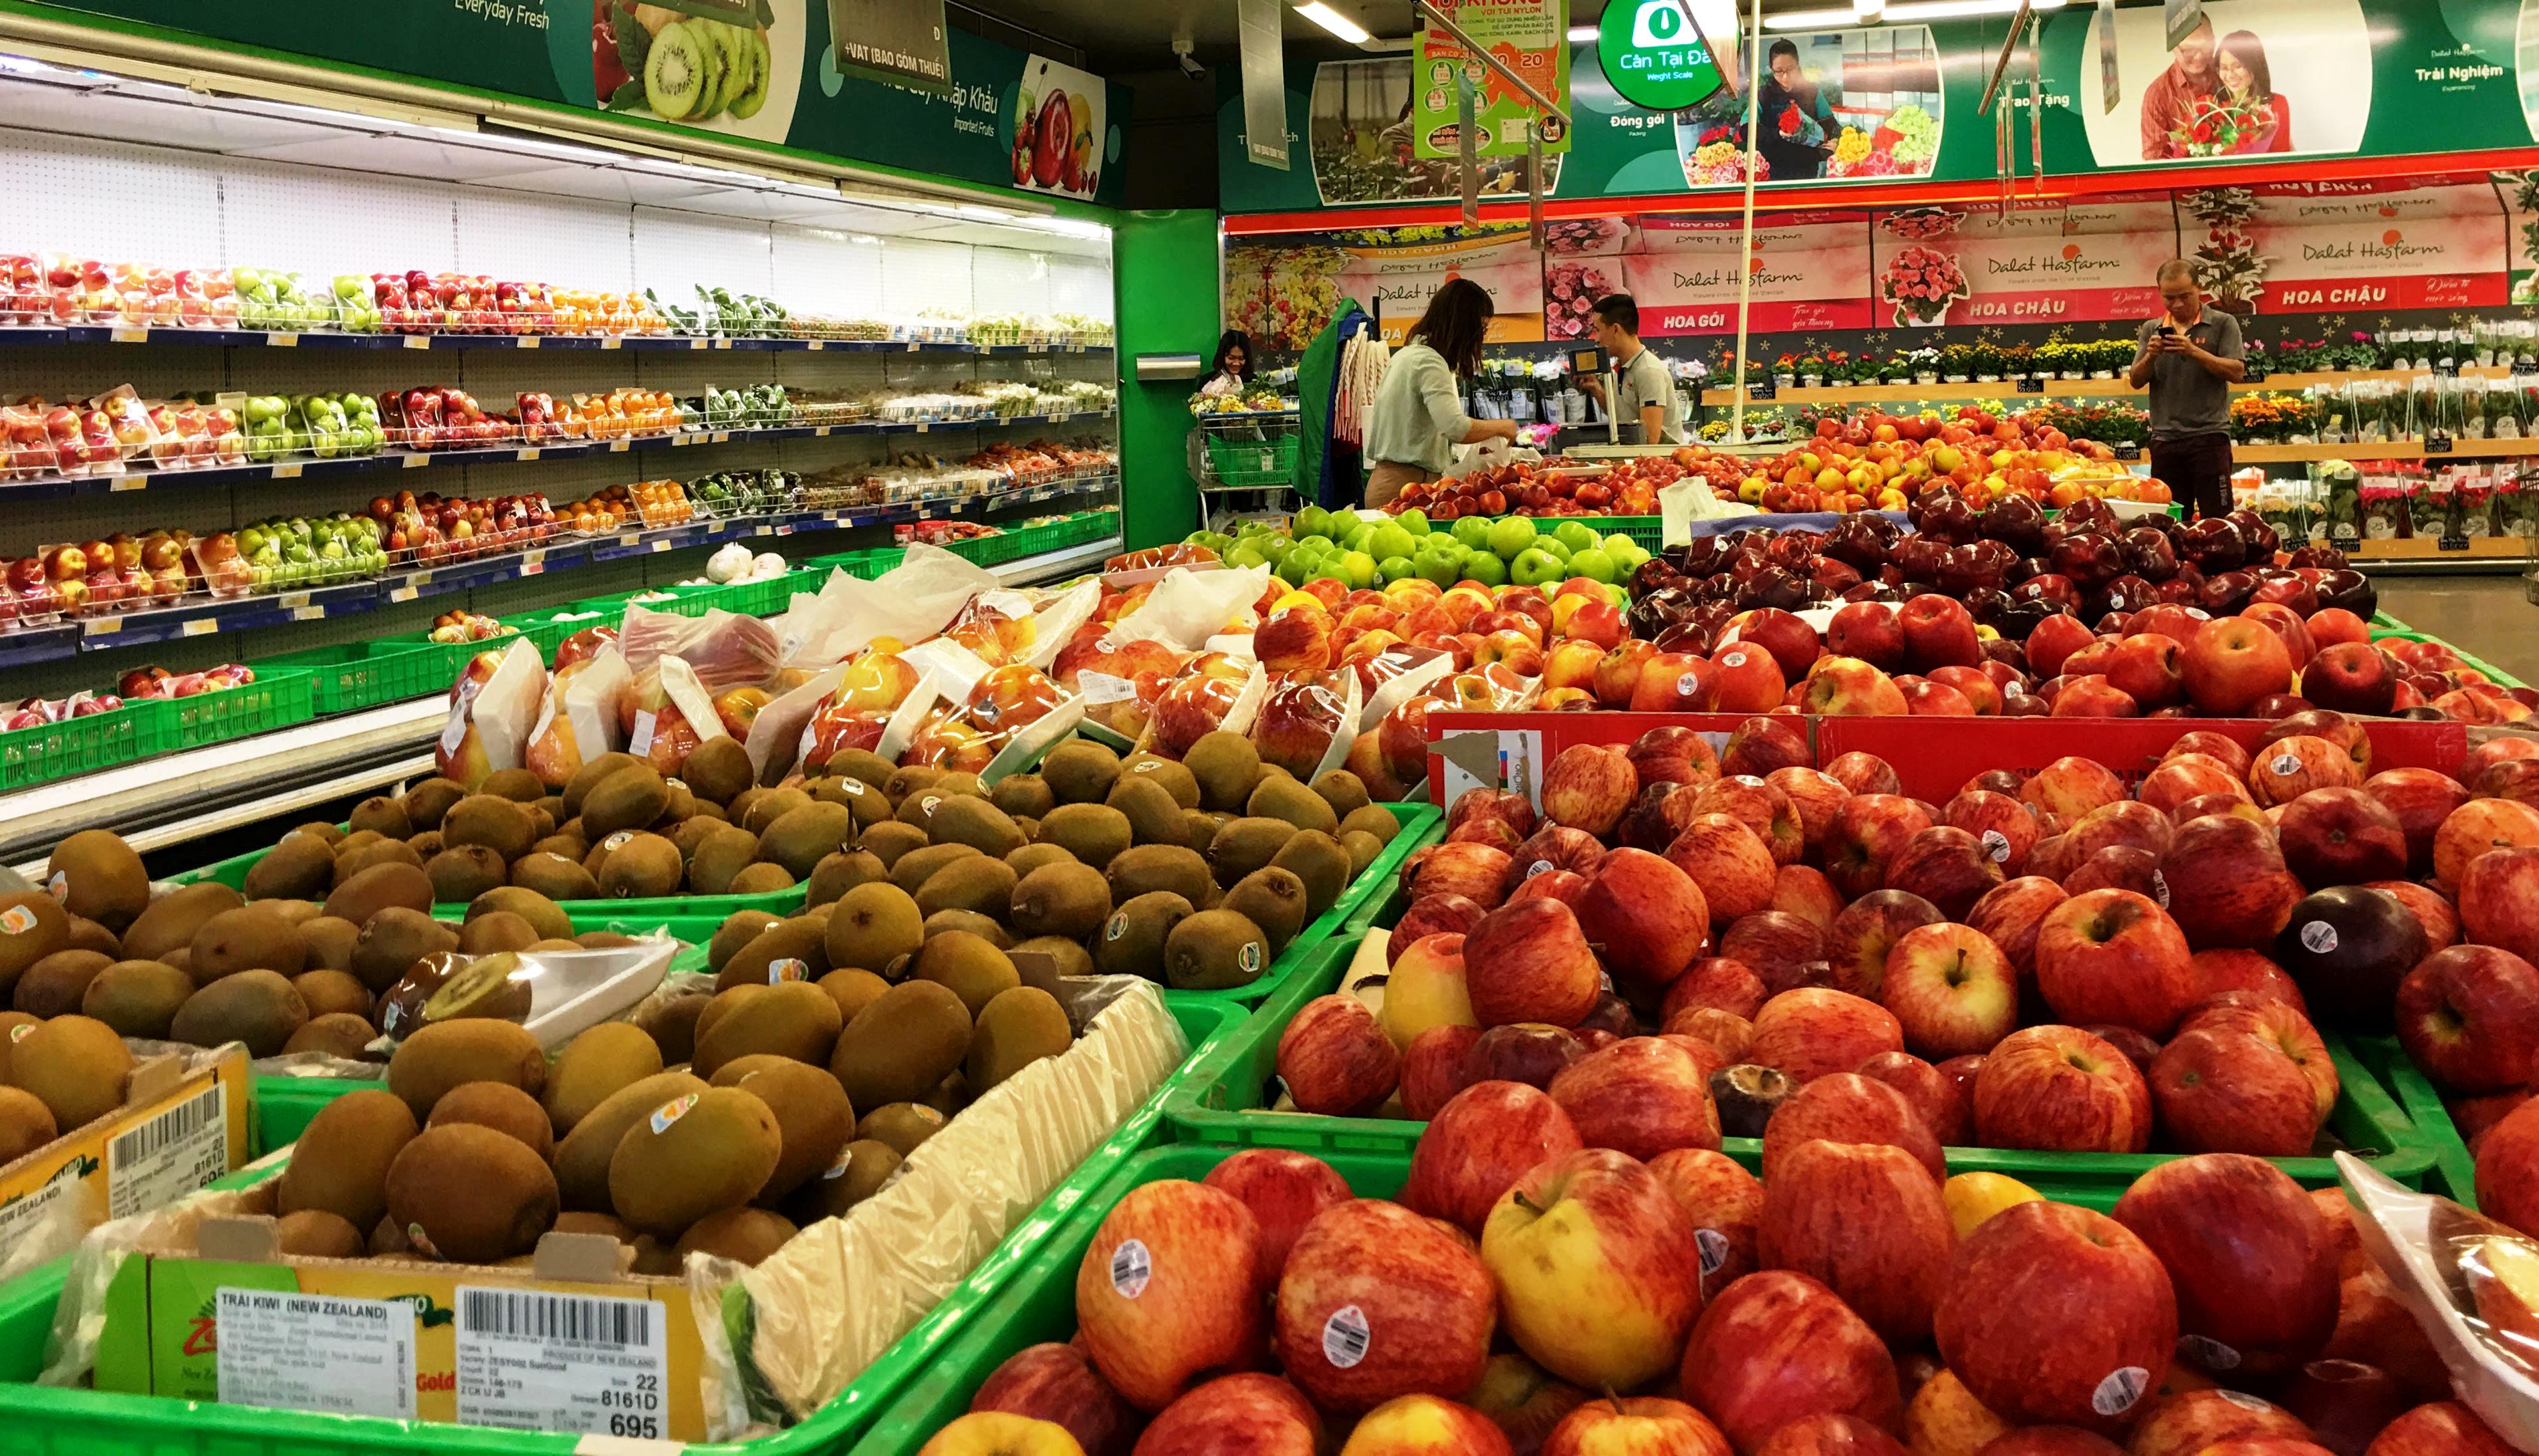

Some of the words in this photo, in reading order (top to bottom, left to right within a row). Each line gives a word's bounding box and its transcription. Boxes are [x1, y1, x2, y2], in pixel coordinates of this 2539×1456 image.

[516, 5, 550, 30] Fresh
[933, 26, 941, 41] Đ
[845, 42, 870, 62] +VAT
[871, 47, 894, 67] (BAO
[896, 48, 918, 72] GỒM
[918, 56, 945, 79] THUẾ)
[1521, 53, 1544, 68] 20
[1620, 53, 1652, 69] Cân
[1658, 51, 1683, 68] Tại
[1647, 72, 1671, 82] Weight
[1673, 71, 1693, 80] Scale
[2449, 64, 2504, 82] Nghiệm
[969, 84, 998, 114] Khẩu
[1999, 96, 2030, 108] Tao
[2038, 93, 2070, 108] Tặng
[954, 116, 978, 134] Imported
[979, 121, 995, 138] Fruits
[1610, 115, 1643, 129] Đóng
[1647, 113, 1665, 128] gói
[2303, 241, 2353, 261] Dalat
[2361, 239, 2442, 260] Hasfarm
[1988, 256, 2036, 274] Dalat
[2042, 253, 2119, 273] Hasfarm
[1673, 269, 1721, 289] Dalat
[1378, 283, 1421, 301] Dalat
[2282, 289, 2324, 306] HOA
[2330, 285, 2387, 306] CHẬU
[1969, 302, 2008, 317] HOA
[2013, 298, 2066, 318] CHẬU
[1663, 316, 1696, 329] HOA
[1698, 312, 1726, 328] GÓI
[1380, 328, 1402, 340] OA
[253, 1296, 280, 1310] KIWI
[286, 1299, 320, 1314] (NEW
[322, 1301, 388, 1322] ZEALAND)
[596, 1354, 615, 1364] NEW
[416, 1370, 456, 1392] Gold
[636, 1373, 658, 1391] 22
[601, 1389, 658, 1411] 8161D
[610, 1413, 658, 1440] 695
